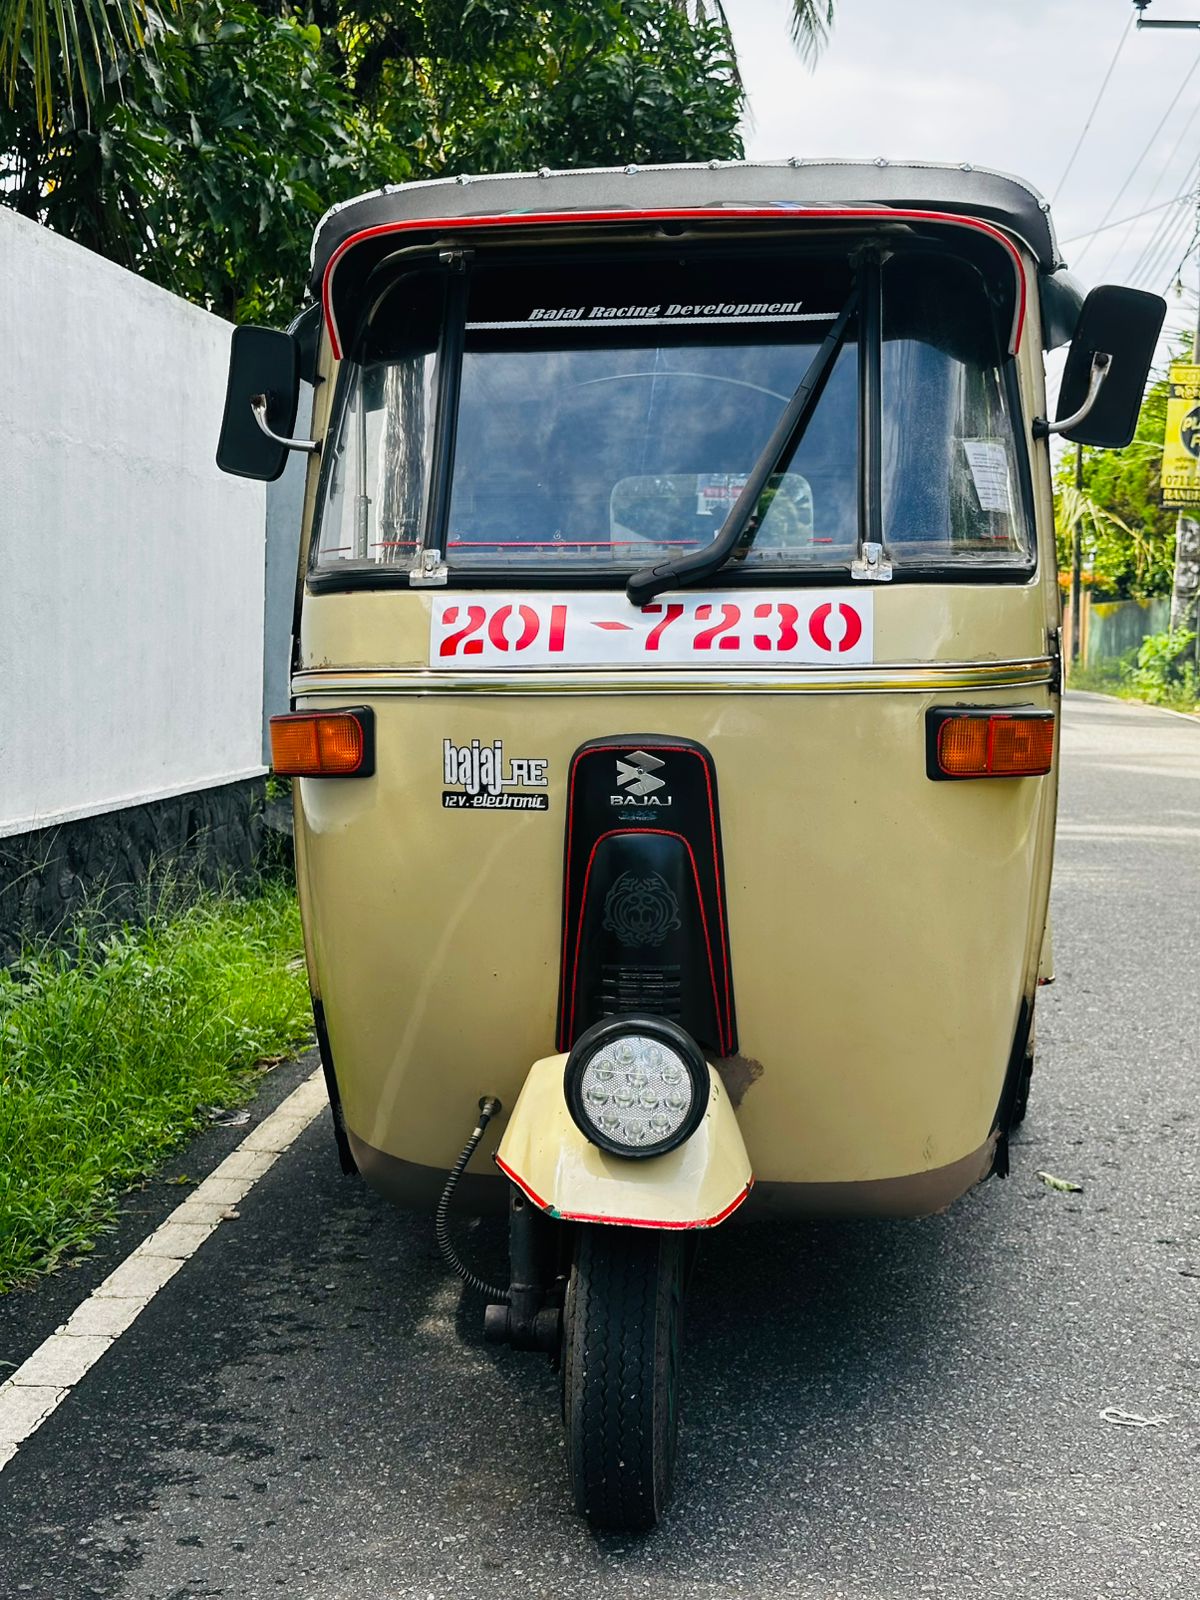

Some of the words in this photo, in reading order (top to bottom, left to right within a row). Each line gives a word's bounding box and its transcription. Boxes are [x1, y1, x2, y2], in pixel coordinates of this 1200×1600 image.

[528, 306, 585, 321] Bajaj
[588, 304, 662, 318] Racing
[664, 301, 804, 317] Development
[439, 604, 568, 657] 201
[641, 601, 863, 653] 7230
[443, 739, 503, 796] bajaj
[610, 795, 673, 807] BAJAJ
